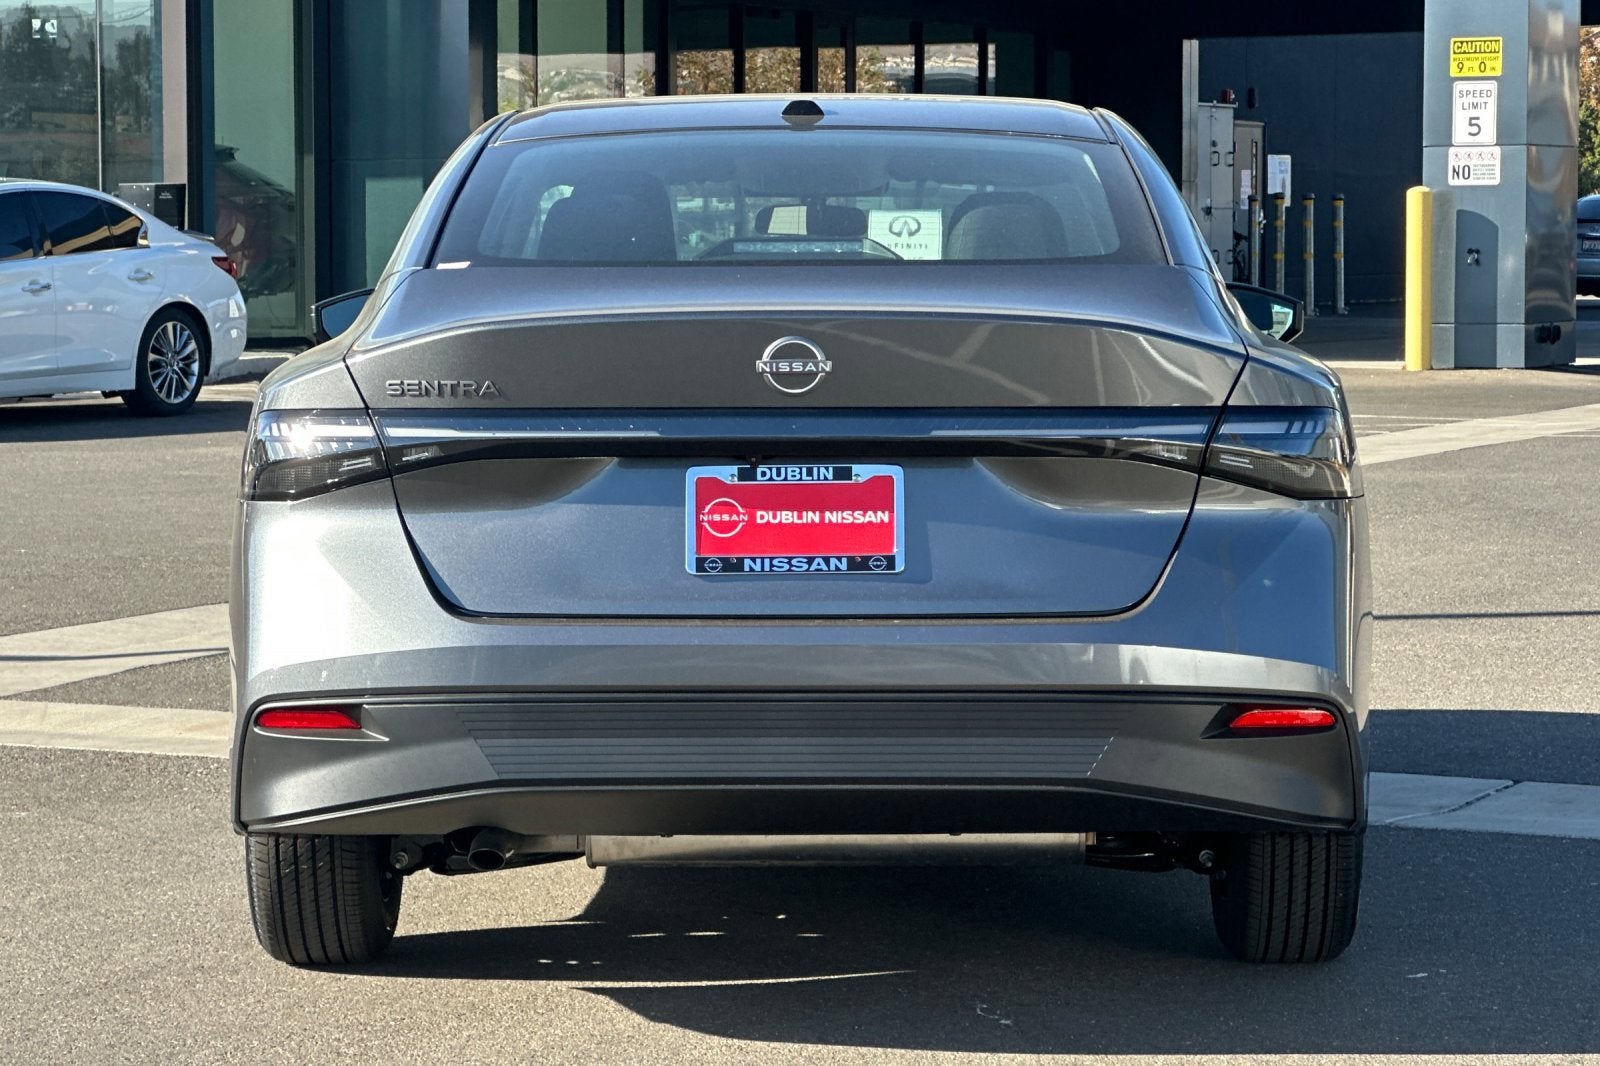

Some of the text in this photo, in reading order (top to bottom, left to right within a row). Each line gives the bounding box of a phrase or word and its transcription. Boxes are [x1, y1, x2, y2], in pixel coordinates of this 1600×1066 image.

[1453, 41, 1499, 53] CAUTION
[1457, 61, 1464, 73] 9
[1478, 61, 1486, 73] 0
[1458, 89, 1492, 98] SPEED
[1461, 101, 1488, 110] LIMIT
[1468, 116, 1482, 136] 5
[1452, 164, 1471, 180] NO
[759, 362, 831, 372] NISSAN
[385, 380, 500, 397] SENTRA
[756, 467, 833, 481] DUBLIN
[756, 511, 889, 524] DUBLIN NISSAN
[743, 557, 848, 572] NISSAN
